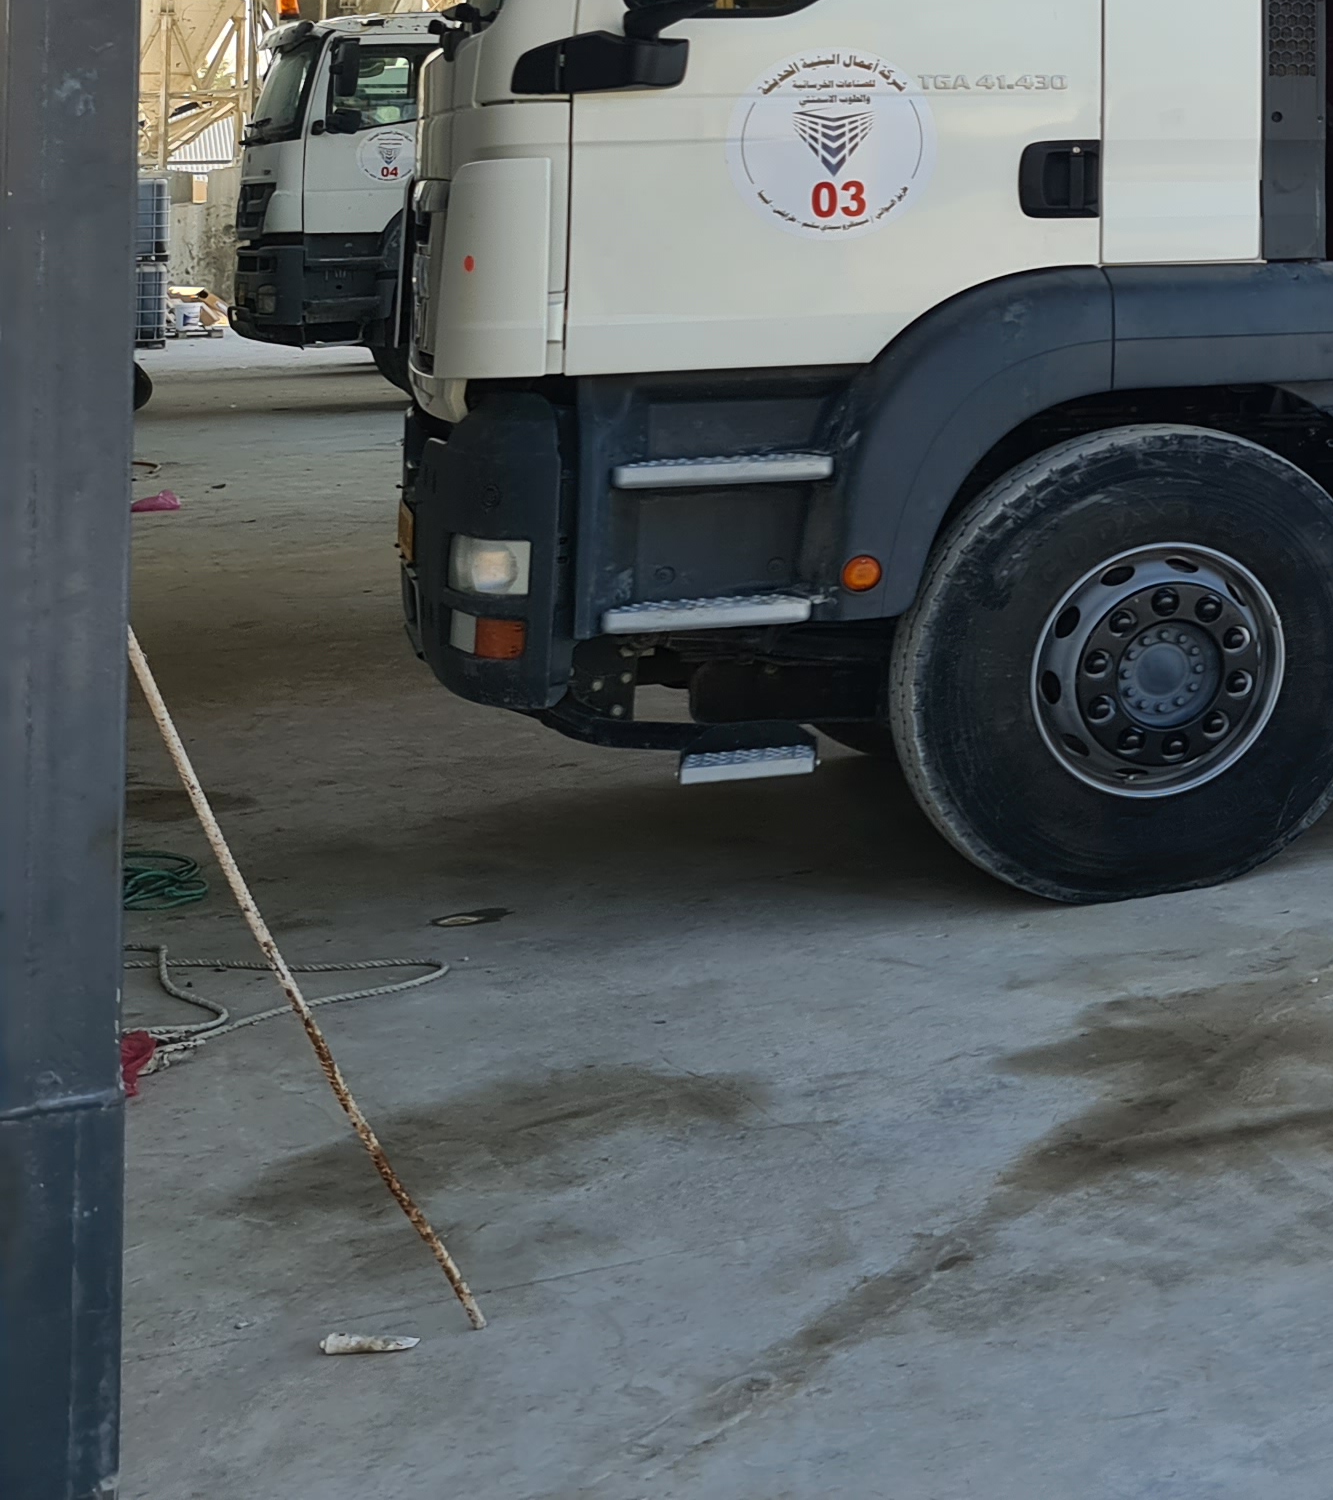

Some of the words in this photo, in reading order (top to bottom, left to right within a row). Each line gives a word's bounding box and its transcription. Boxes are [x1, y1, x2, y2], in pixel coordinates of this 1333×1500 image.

[801, 53, 840, 70] البنية
[842, 55, 880, 73] أعمال
[757, 62, 800, 95] الحديثة
[879, 65, 908, 92] شركة
[918, 74, 971, 90] TGA
[975, 74, 1068, 90] 41.430
[380, 166, 399, 177] 04
[812, 180, 866, 219] 03
